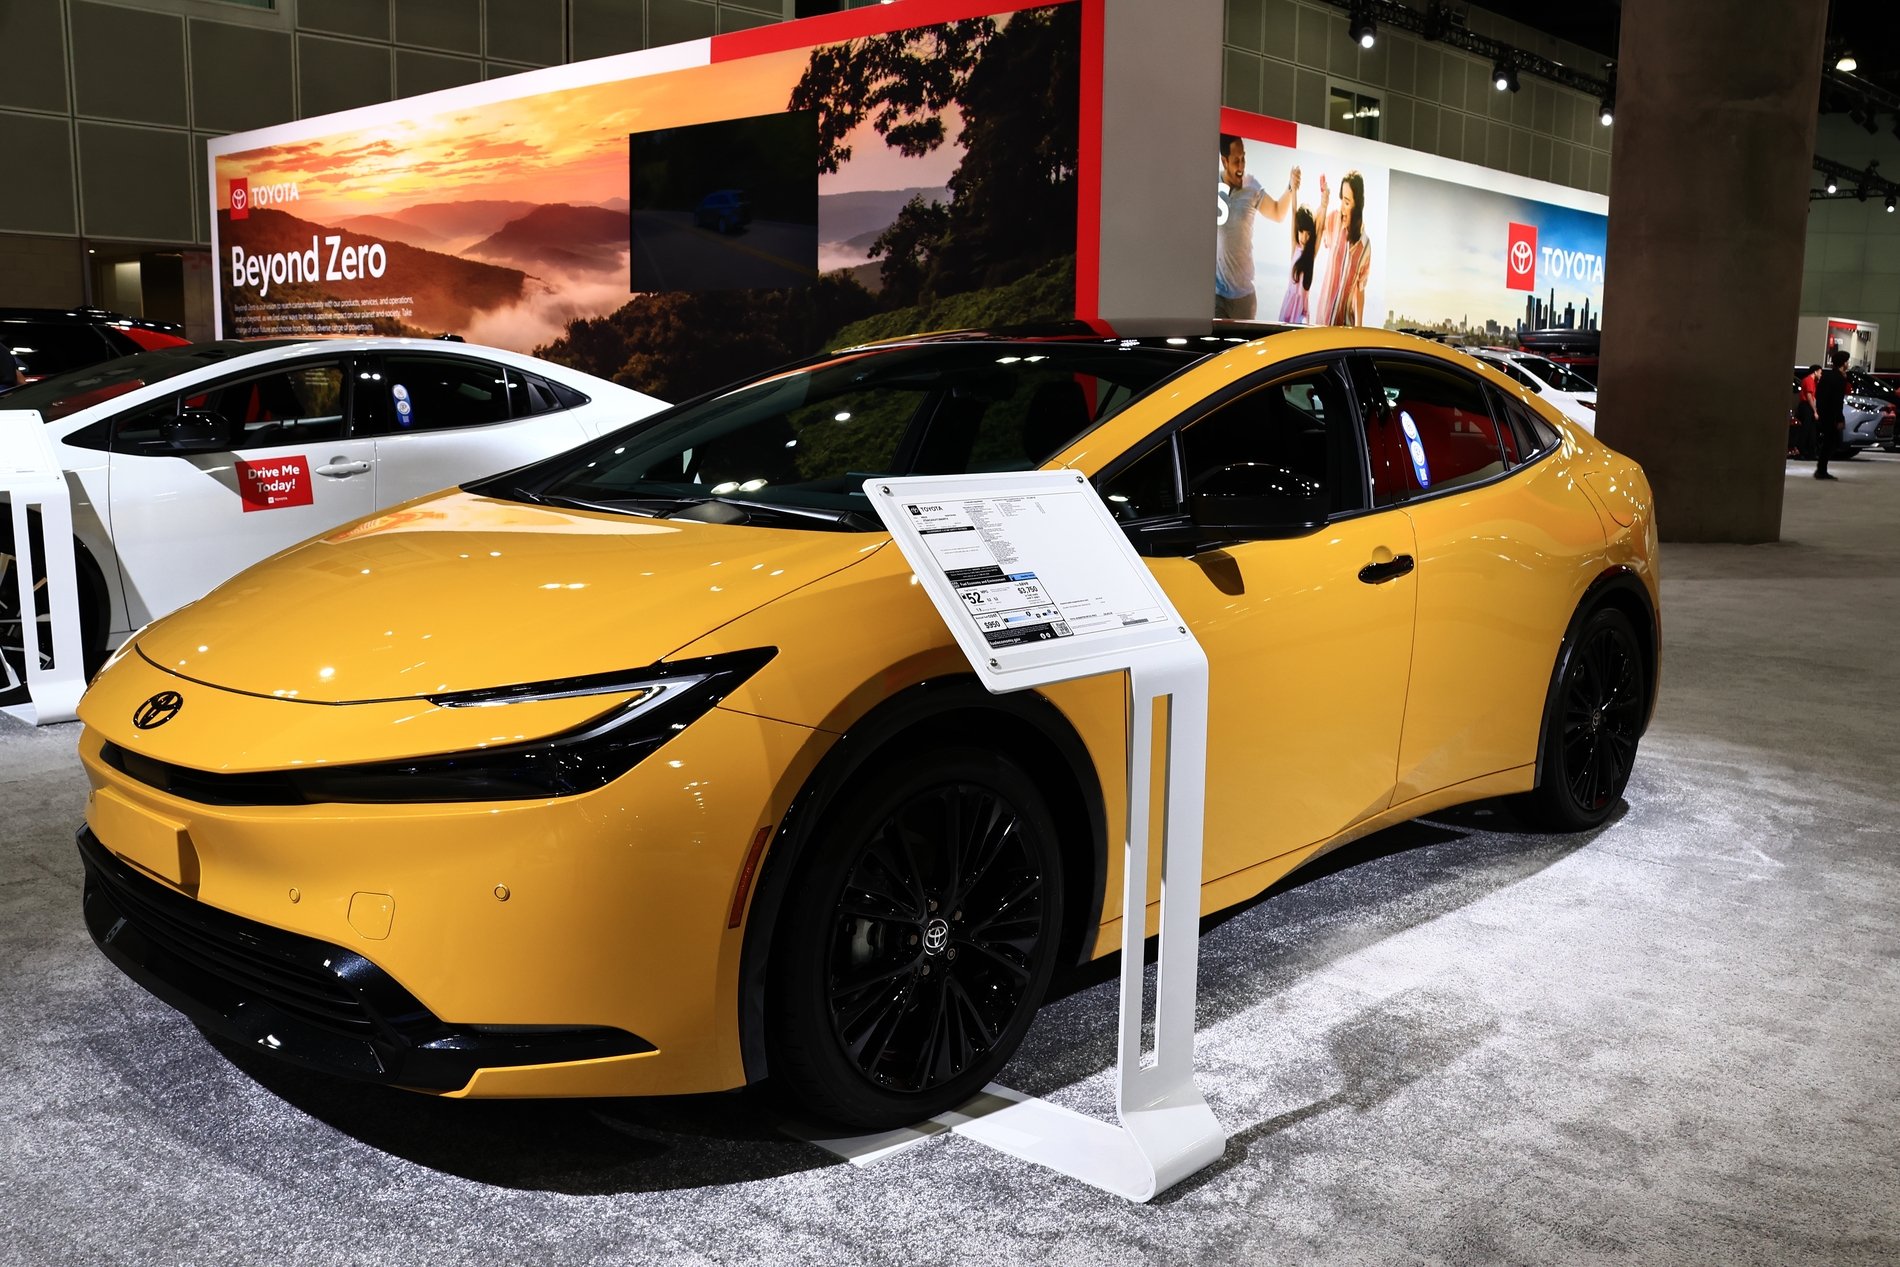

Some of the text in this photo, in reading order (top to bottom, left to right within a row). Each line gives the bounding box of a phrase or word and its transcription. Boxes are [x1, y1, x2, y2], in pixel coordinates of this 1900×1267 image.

[252, 182, 300, 206] TOYOTA
[231, 235, 386, 296] Beyond Zero
[1542, 246, 1604, 282] TOYOTA
[380, 297, 388, 305] and
[402, 308, 412, 316] Take
[248, 465, 300, 479] Drive Me
[256, 478, 296, 492] Today!
[1018, 586, 1038, 594] $3,750
[966, 592, 984, 604] 52
[984, 621, 1001, 629] $950
